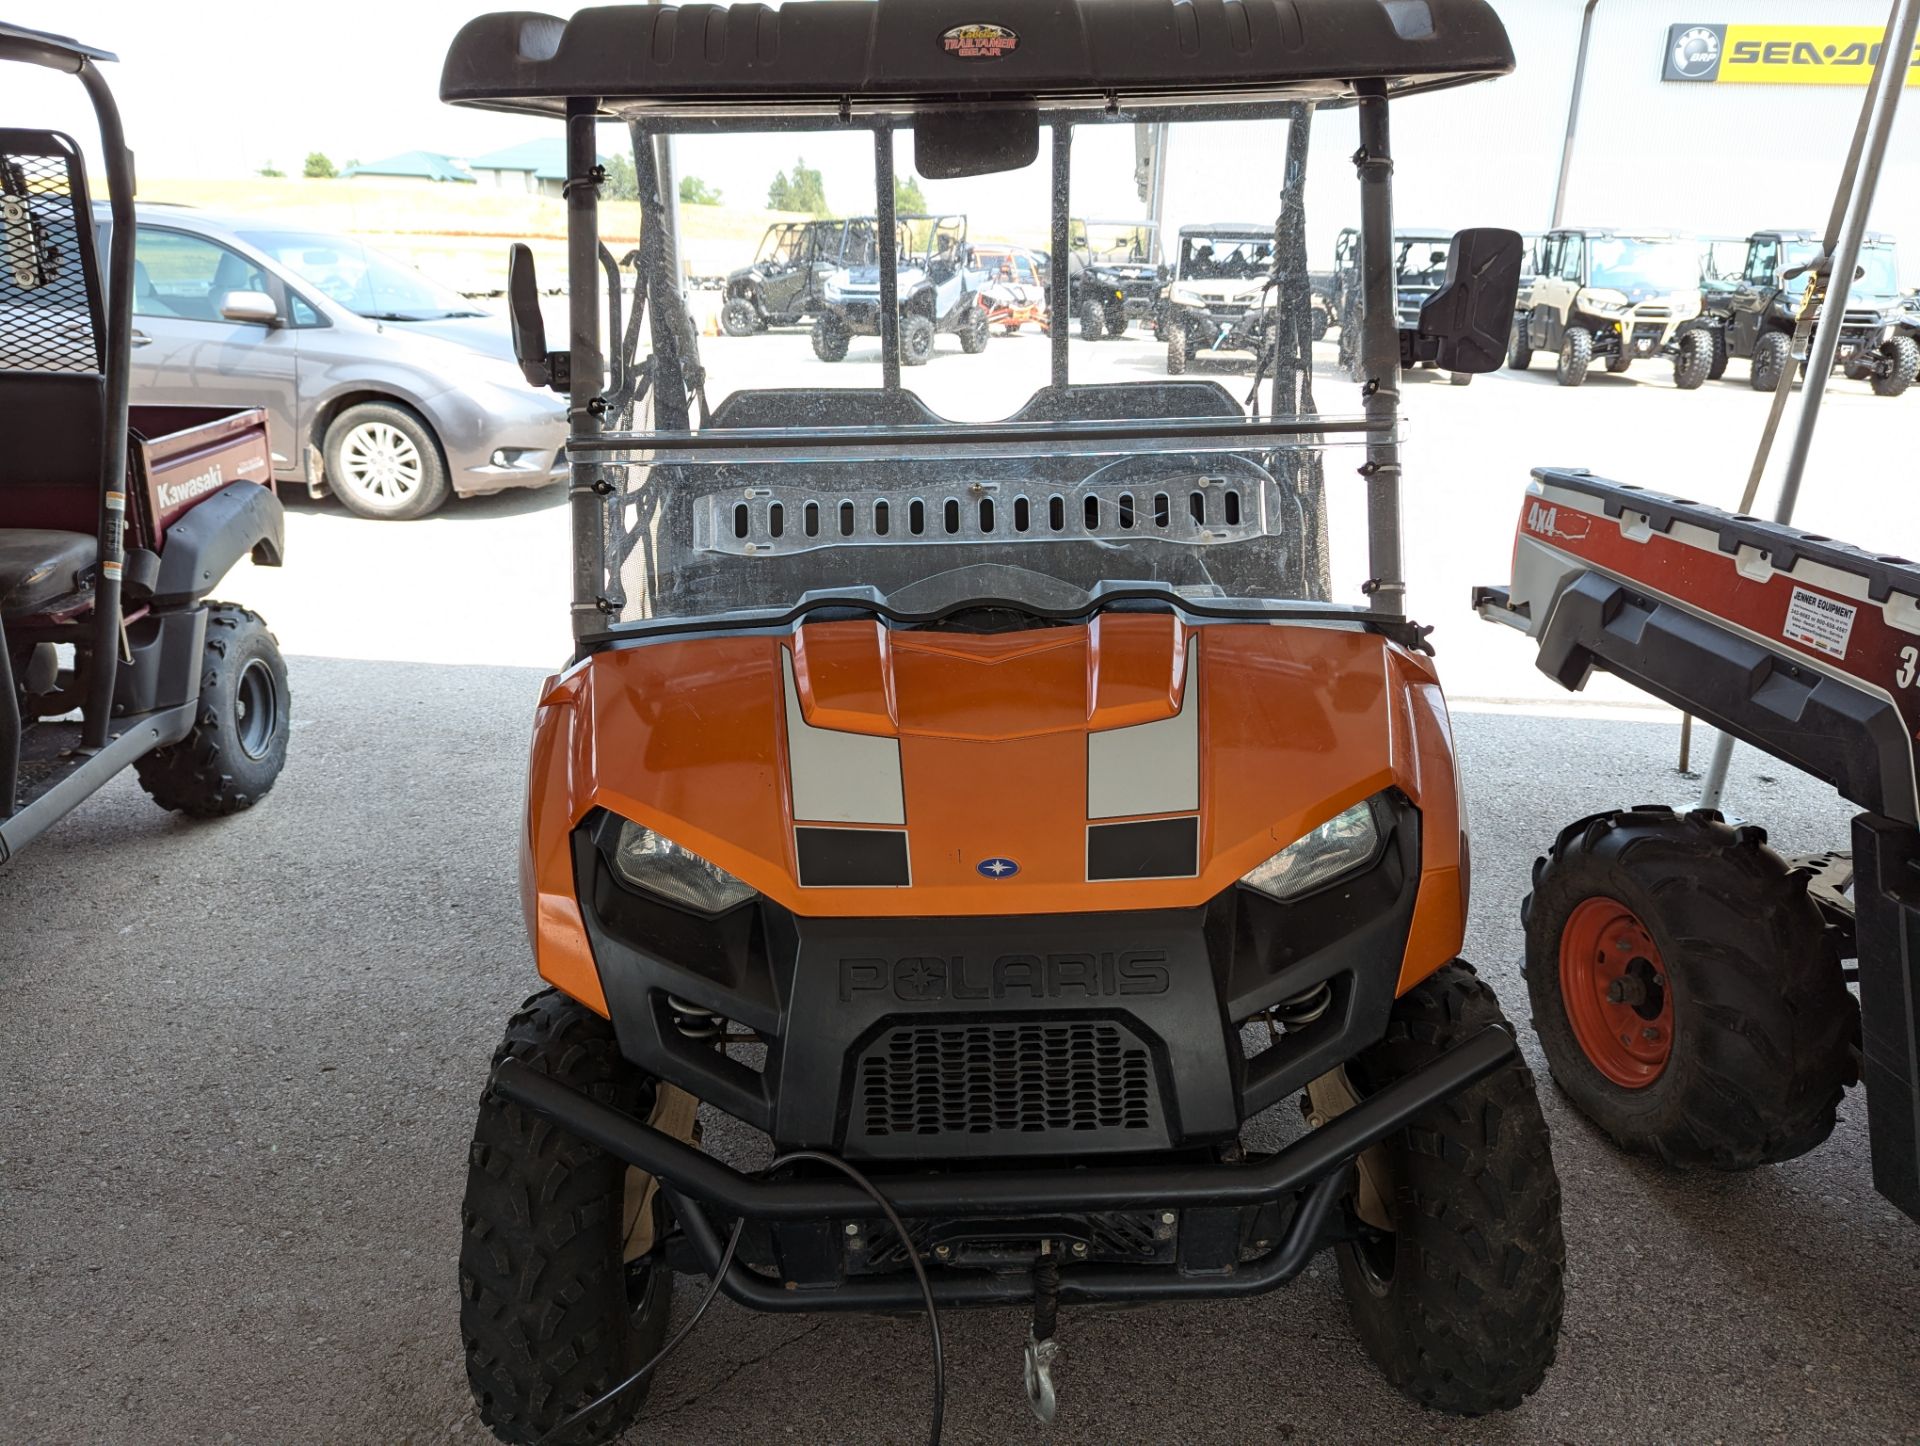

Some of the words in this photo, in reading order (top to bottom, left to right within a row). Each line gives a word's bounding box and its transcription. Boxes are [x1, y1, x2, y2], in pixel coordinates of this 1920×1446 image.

[958, 47, 1001, 56] GEAR
[1690, 52, 1717, 62] BRP
[157, 464, 223, 509] Kawasaki
[1793, 591, 1817, 606] JENNER
[1817, 599, 1853, 620] EQUIPMENT
[839, 950, 1170, 1002] POLARIS
